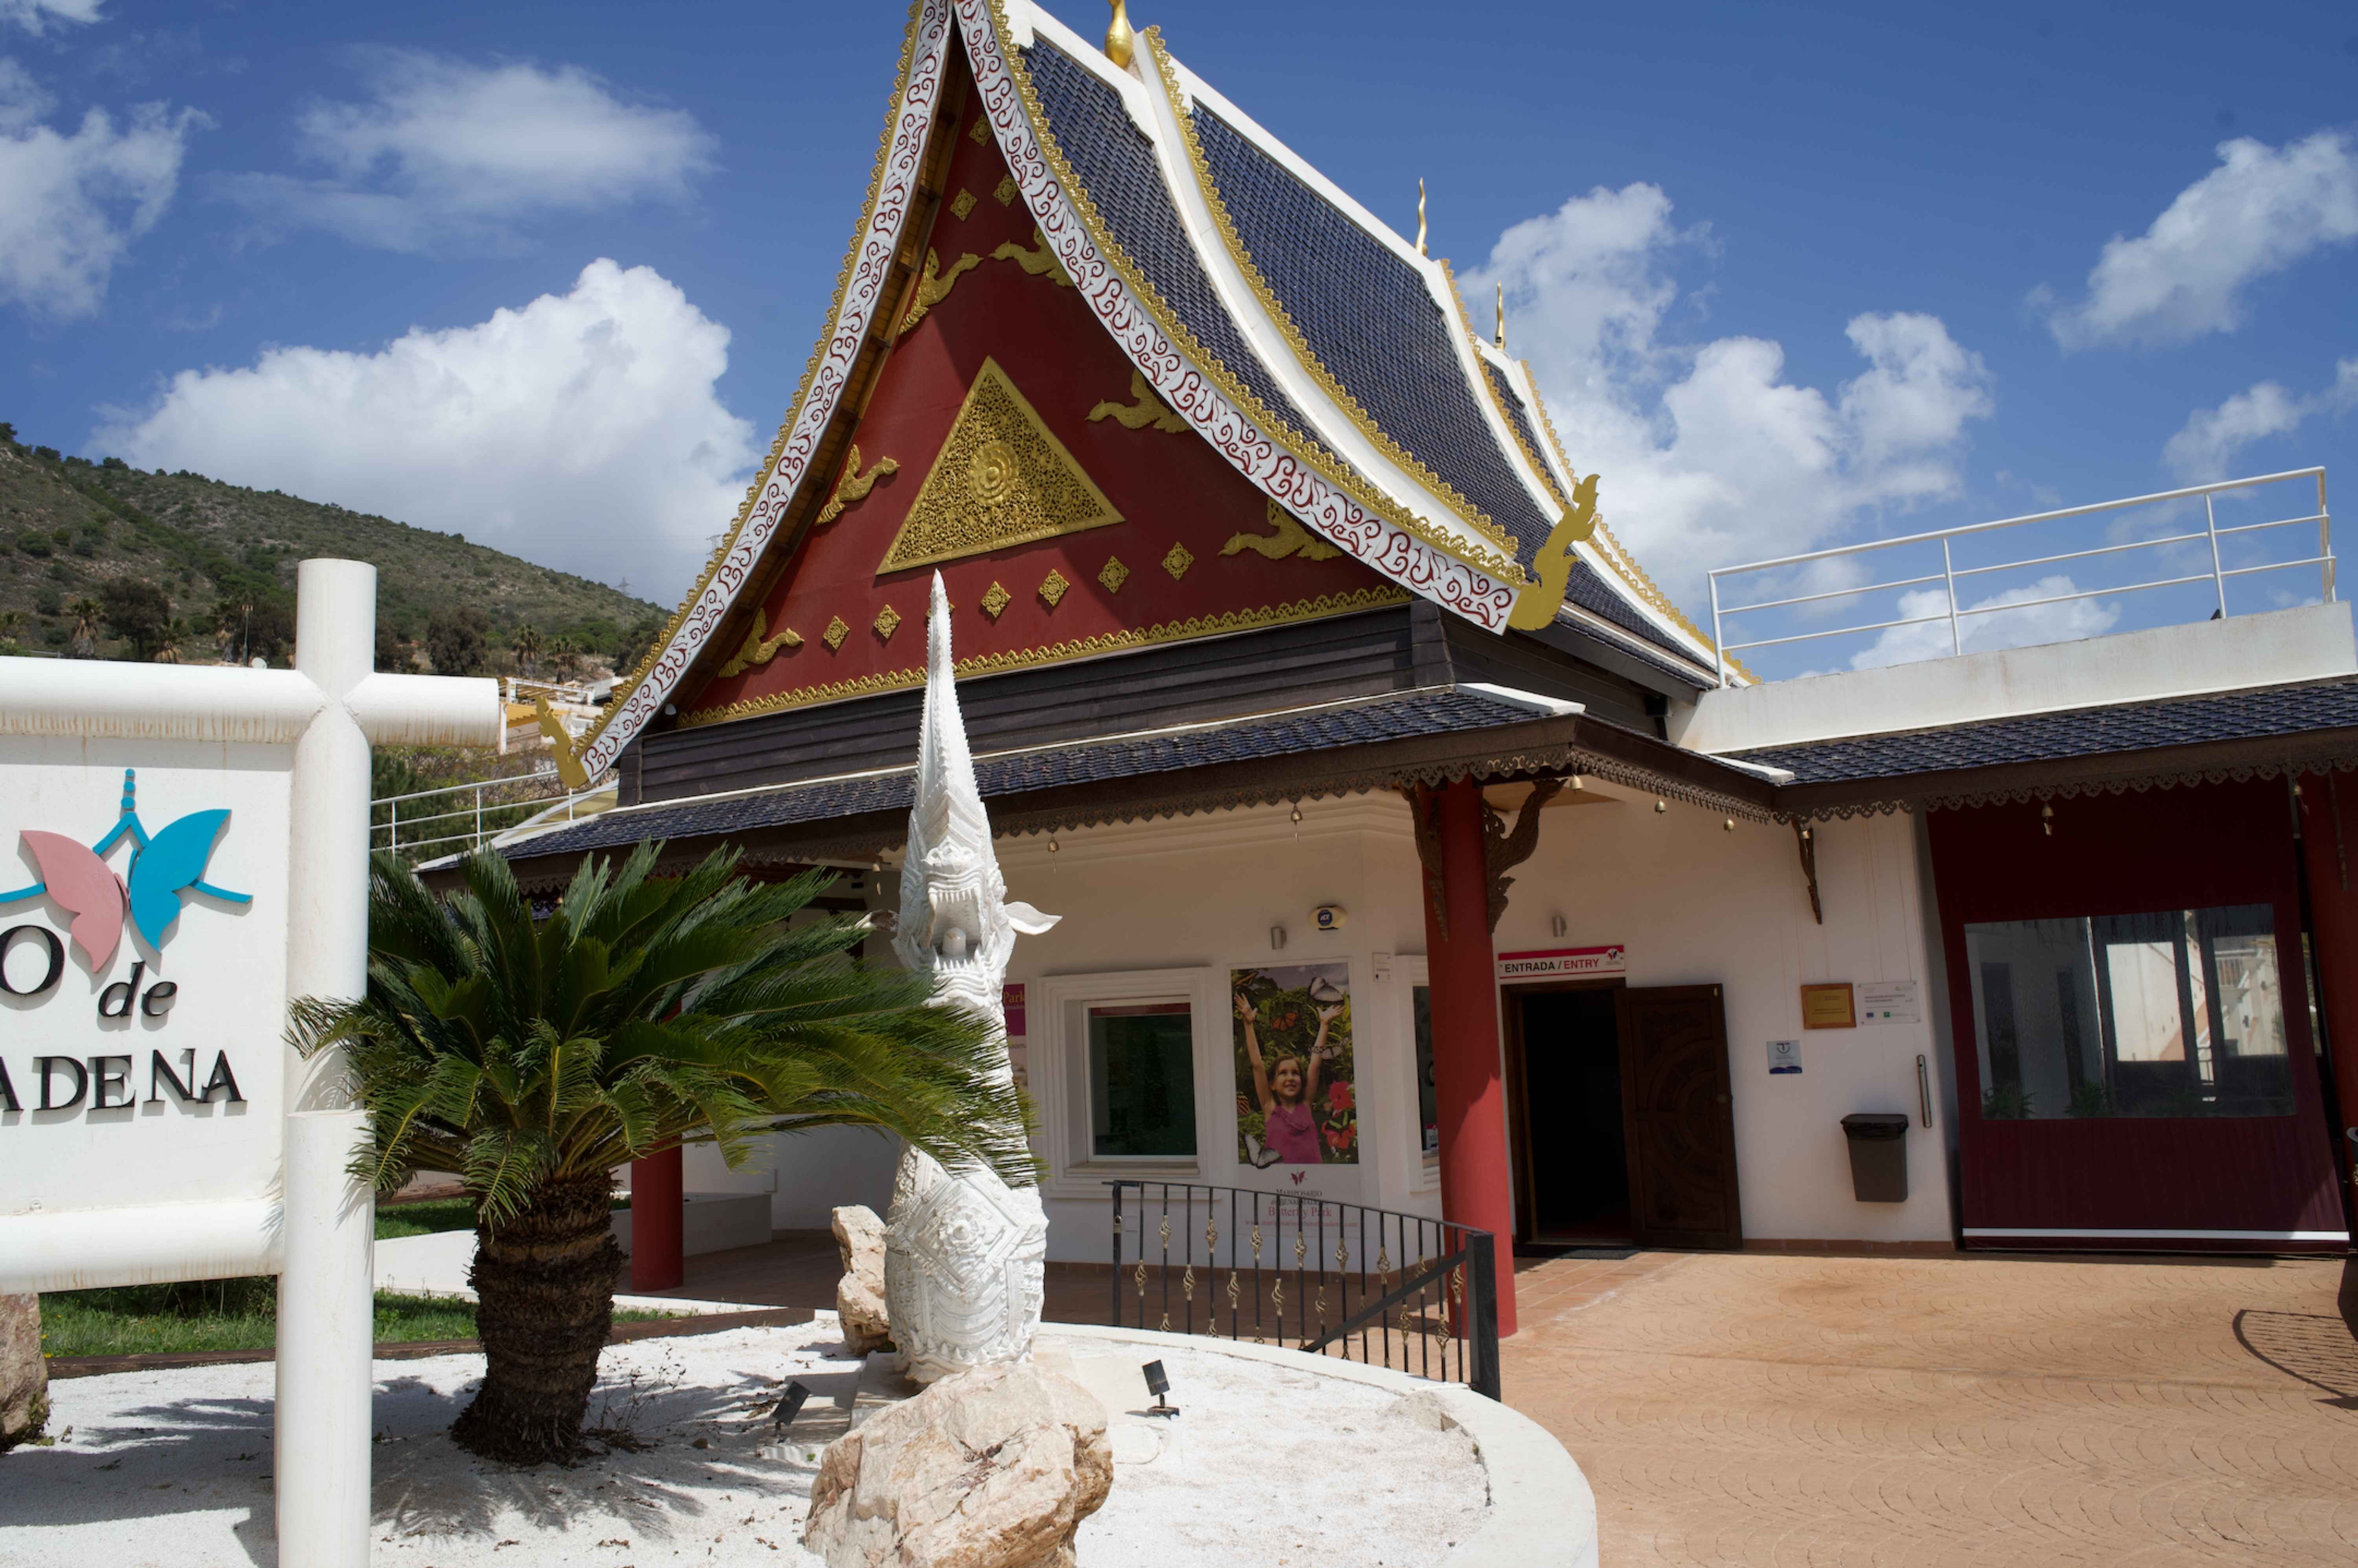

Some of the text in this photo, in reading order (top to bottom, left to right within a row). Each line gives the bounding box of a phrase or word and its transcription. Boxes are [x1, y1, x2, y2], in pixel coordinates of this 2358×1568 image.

[1505, 962, 1555, 973] ENTRADA
[1564, 959, 1599, 969] ENTRY
[98, 960, 178, 1017] de
[1311, 1207, 1333, 1217] Prk
